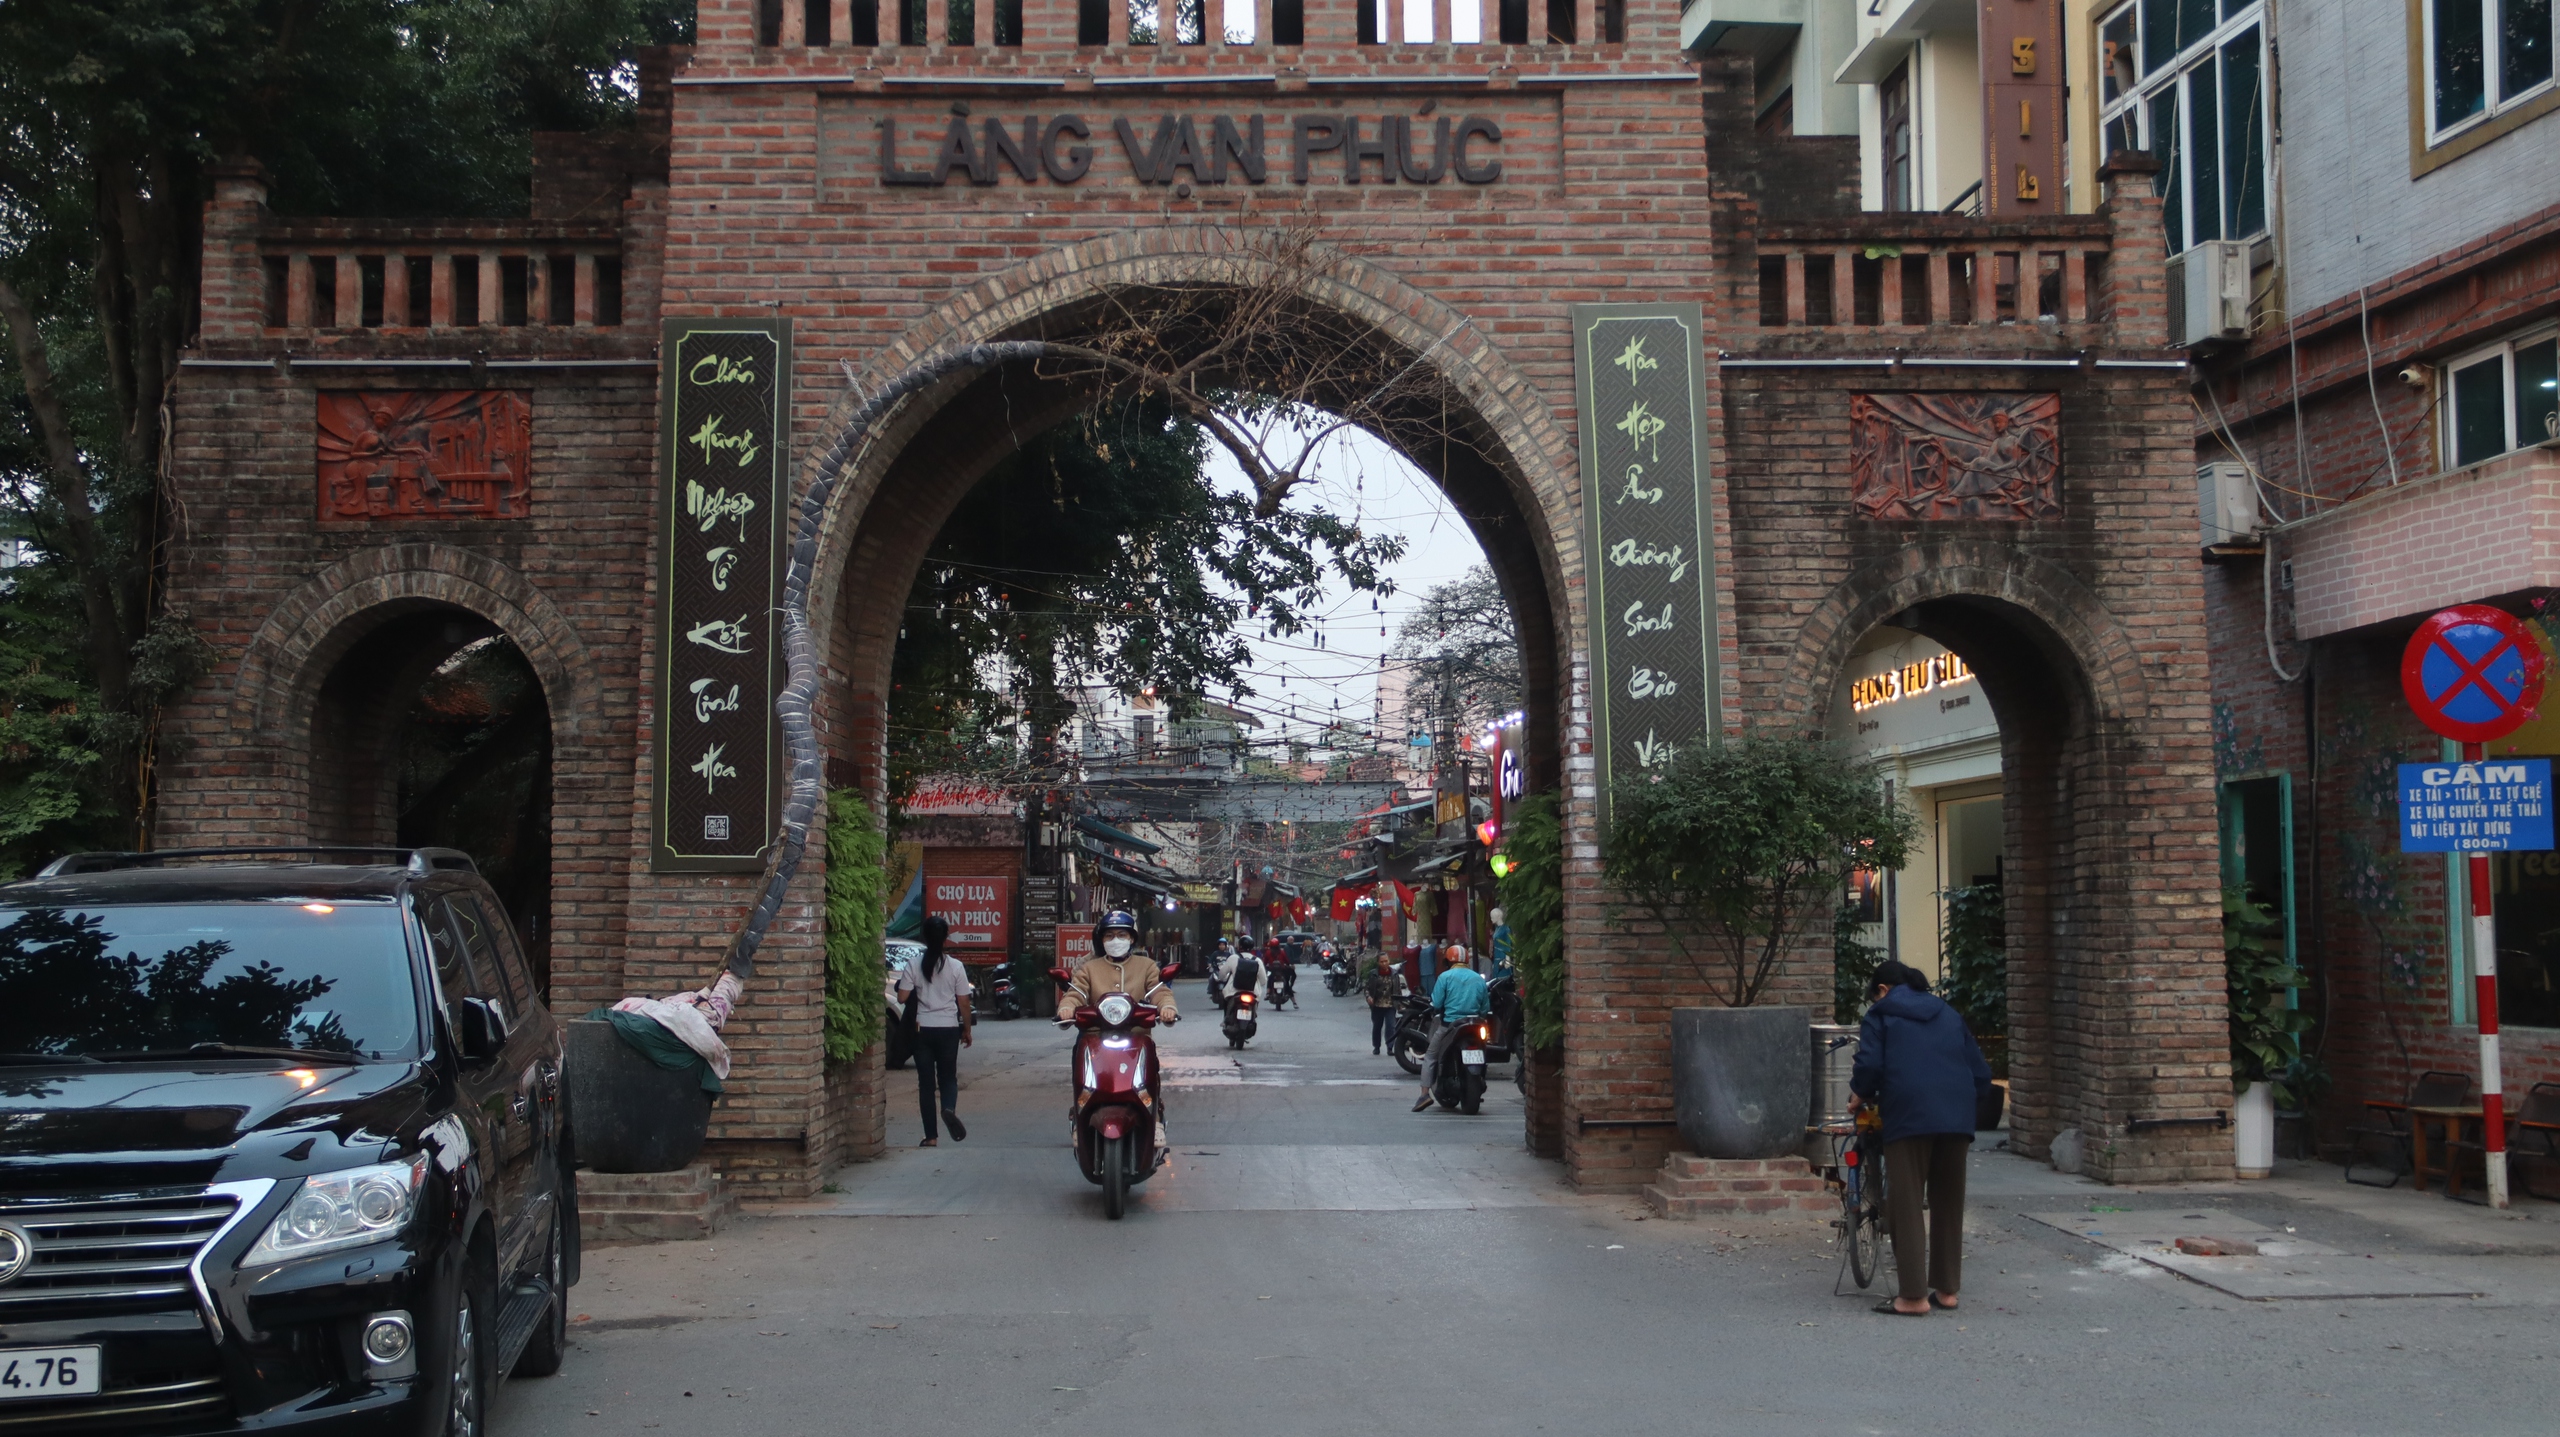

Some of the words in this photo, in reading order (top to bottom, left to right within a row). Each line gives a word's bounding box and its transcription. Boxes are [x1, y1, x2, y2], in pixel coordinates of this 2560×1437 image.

[882, 101, 1093, 187] LÀNG
[1114, 113, 1266, 198] VẠN
[1295, 100, 1502, 185] PHÚC
[690, 354, 754, 385] Chấn
[1614, 333, 1658, 386] Hoa
[689, 414, 761, 467] Hưng
[1616, 400, 1665, 463] Hợp
[686, 479, 755, 543] Nghiệp
[1624, 600, 1673, 637] Sinh
[689, 677, 739, 723] Tinh
[1628, 665, 1678, 700] Bảo
[691, 740, 737, 795] Hoa
[2422, 761, 2526, 786] CẤM
[2409, 789, 2421, 802] XE
[2426, 785, 2442, 801] TẢI
[2489, 787, 2502, 800] XE
[2522, 781, 2542, 799] CHẾ
[2410, 806, 2422, 820] XE
[2426, 804, 2445, 821] VẬN
[2449, 800, 2488, 818] CHUYỂN
[2493, 799, 2512, 817] PHẾ
[2518, 799, 2542, 817] THẢI
[2411, 822, 2427, 839] VẬT
[2433, 820, 2455, 838] LIỆU
[2484, 821, 2511, 838] DỰNG
[936, 883, 965, 904] CHỢ
[968, 885, 995, 905] LỤA
[964, 907, 1002, 926] PHÚC
[2, 1357, 78, 1389] 4.76
